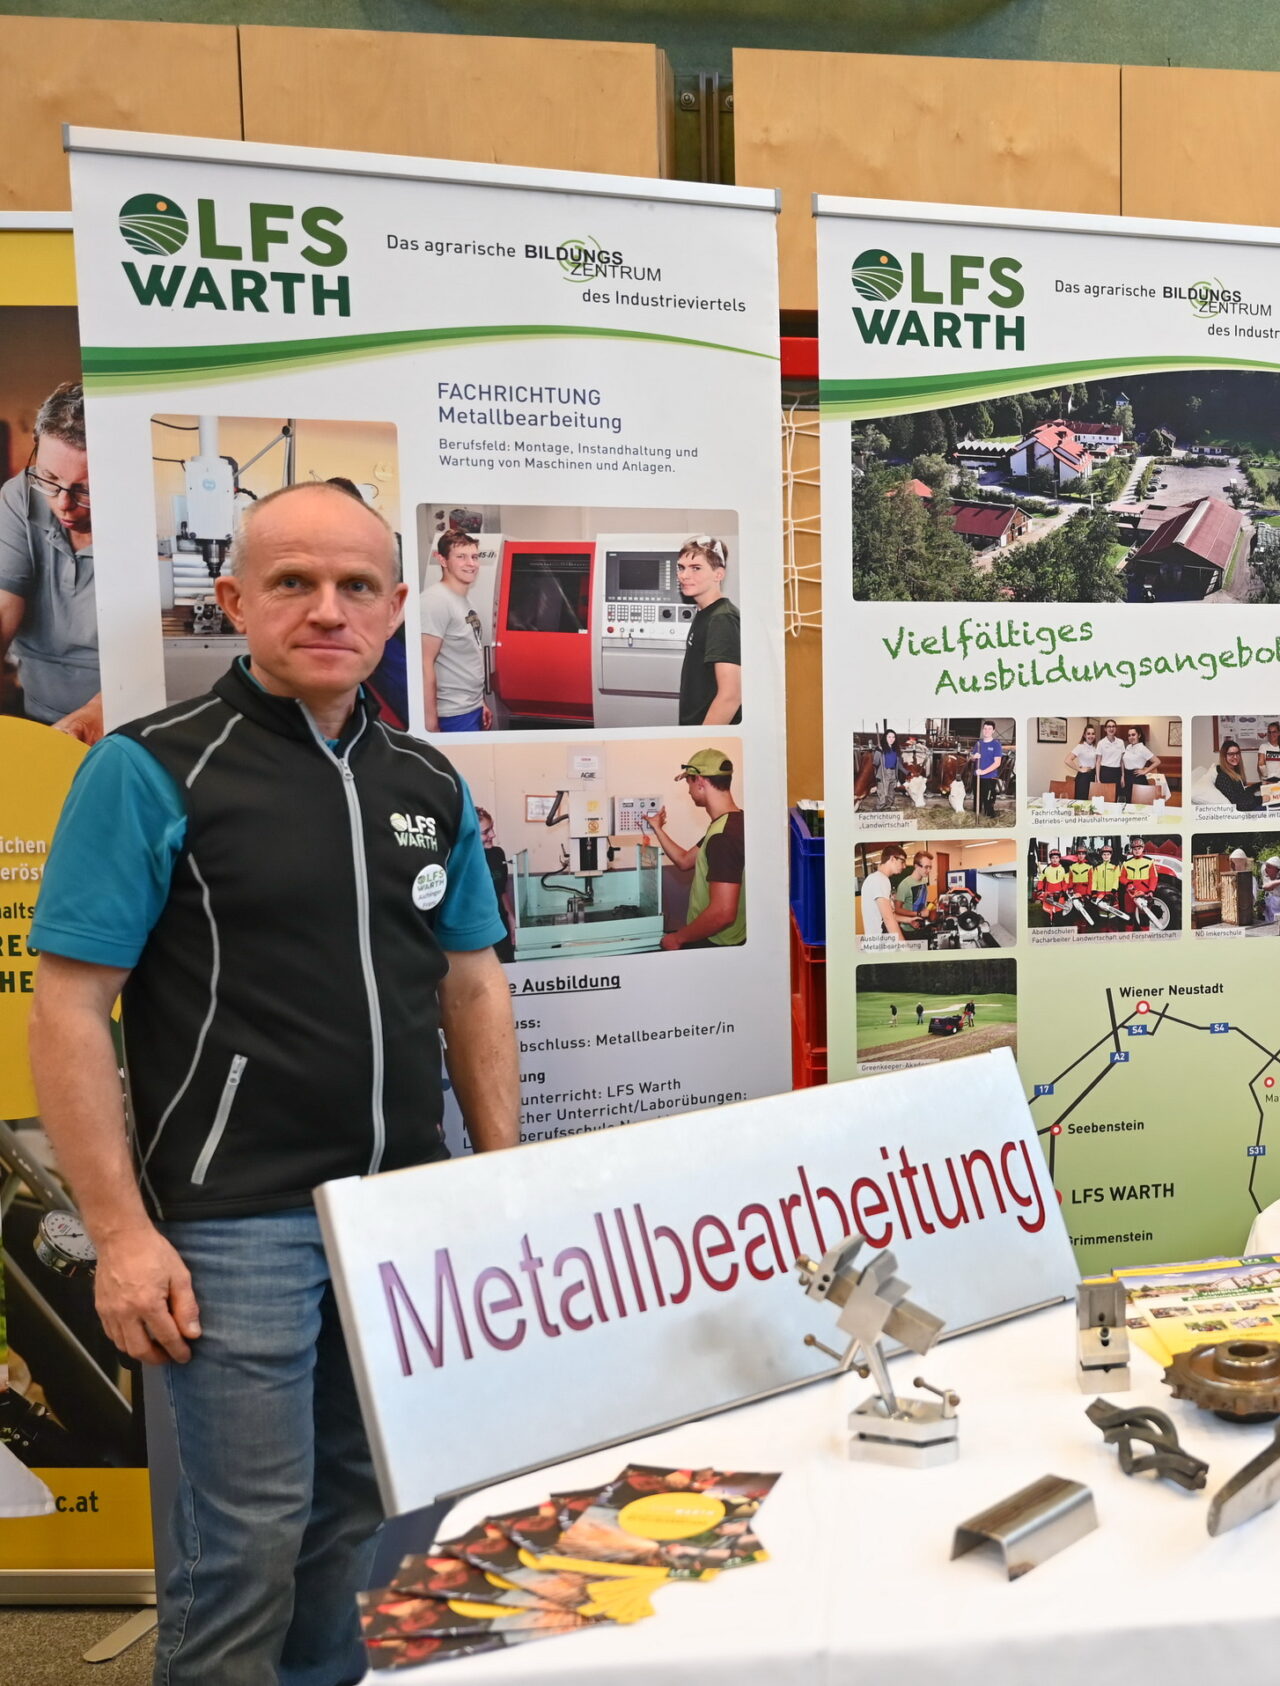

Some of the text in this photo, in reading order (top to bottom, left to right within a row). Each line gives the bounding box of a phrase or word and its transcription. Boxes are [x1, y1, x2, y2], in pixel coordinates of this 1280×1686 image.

[197, 197, 348, 268] LFS
[386, 234, 624, 265] Das agrarische BILDUNGS
[569, 262, 662, 282] ZENTRUM
[910, 252, 1026, 309] LFS
[121, 261, 351, 317] WARTH
[1054, 279, 1242, 303] Das agrarische BILDUNGS
[582, 288, 747, 313] des Industrieviertels
[1198, 300, 1272, 317] ZENTRUM
[851, 307, 1026, 352] WARTH
[1207, 322, 1231, 338] des
[437, 382, 601, 406] FACHRICHTUNG
[438, 406, 623, 434] Metallbearbeitung
[438, 438, 699, 460] Berufsfeld: Montage, Instandhaltung und
[438, 455, 676, 475] Wartung von Maschinen und Anlagen.
[882, 618, 1094, 661] Vielfältiges
[858, 813, 901, 821] Fachrichtung
[1031, 809, 1072, 817] Fachrichtung
[1195, 805, 1234, 813] Fachrichtung
[405, 813, 436, 836] LFS
[393, 831, 438, 852] WARTH
[0, 902, 36, 919] alts
[860, 934, 896, 942] Ausbildung
[1031, 935, 1071, 944] Facharbeiter
[1072, 934, 1118, 942] Landwirtschaft
[1131, 932, 1177, 940] Forstwirtschaft
[1205, 929, 1242, 937] Imkerschule
[522, 974, 621, 994] Ausbildung
[1119, 983, 1224, 998] Wiener Neustadt
[520, 1021, 735, 1052] bschluss: Metallbearbeiter/in
[1132, 1026, 1143, 1034] S4
[1213, 1024, 1225, 1032] S4
[1113, 1052, 1126, 1061] A2
[520, 1078, 681, 1106] unterricht: LFS Warth
[1039, 1085, 1049, 1094] 17
[556, 1090, 748, 1121] Unterricht/Laborübungen:
[1067, 1119, 1145, 1135] Seebenstein
[1248, 1146, 1264, 1155] S31
[1072, 1182, 1175, 1204] LFS WARTH
[378, 1138, 1047, 1378] Metallbearbeitung
